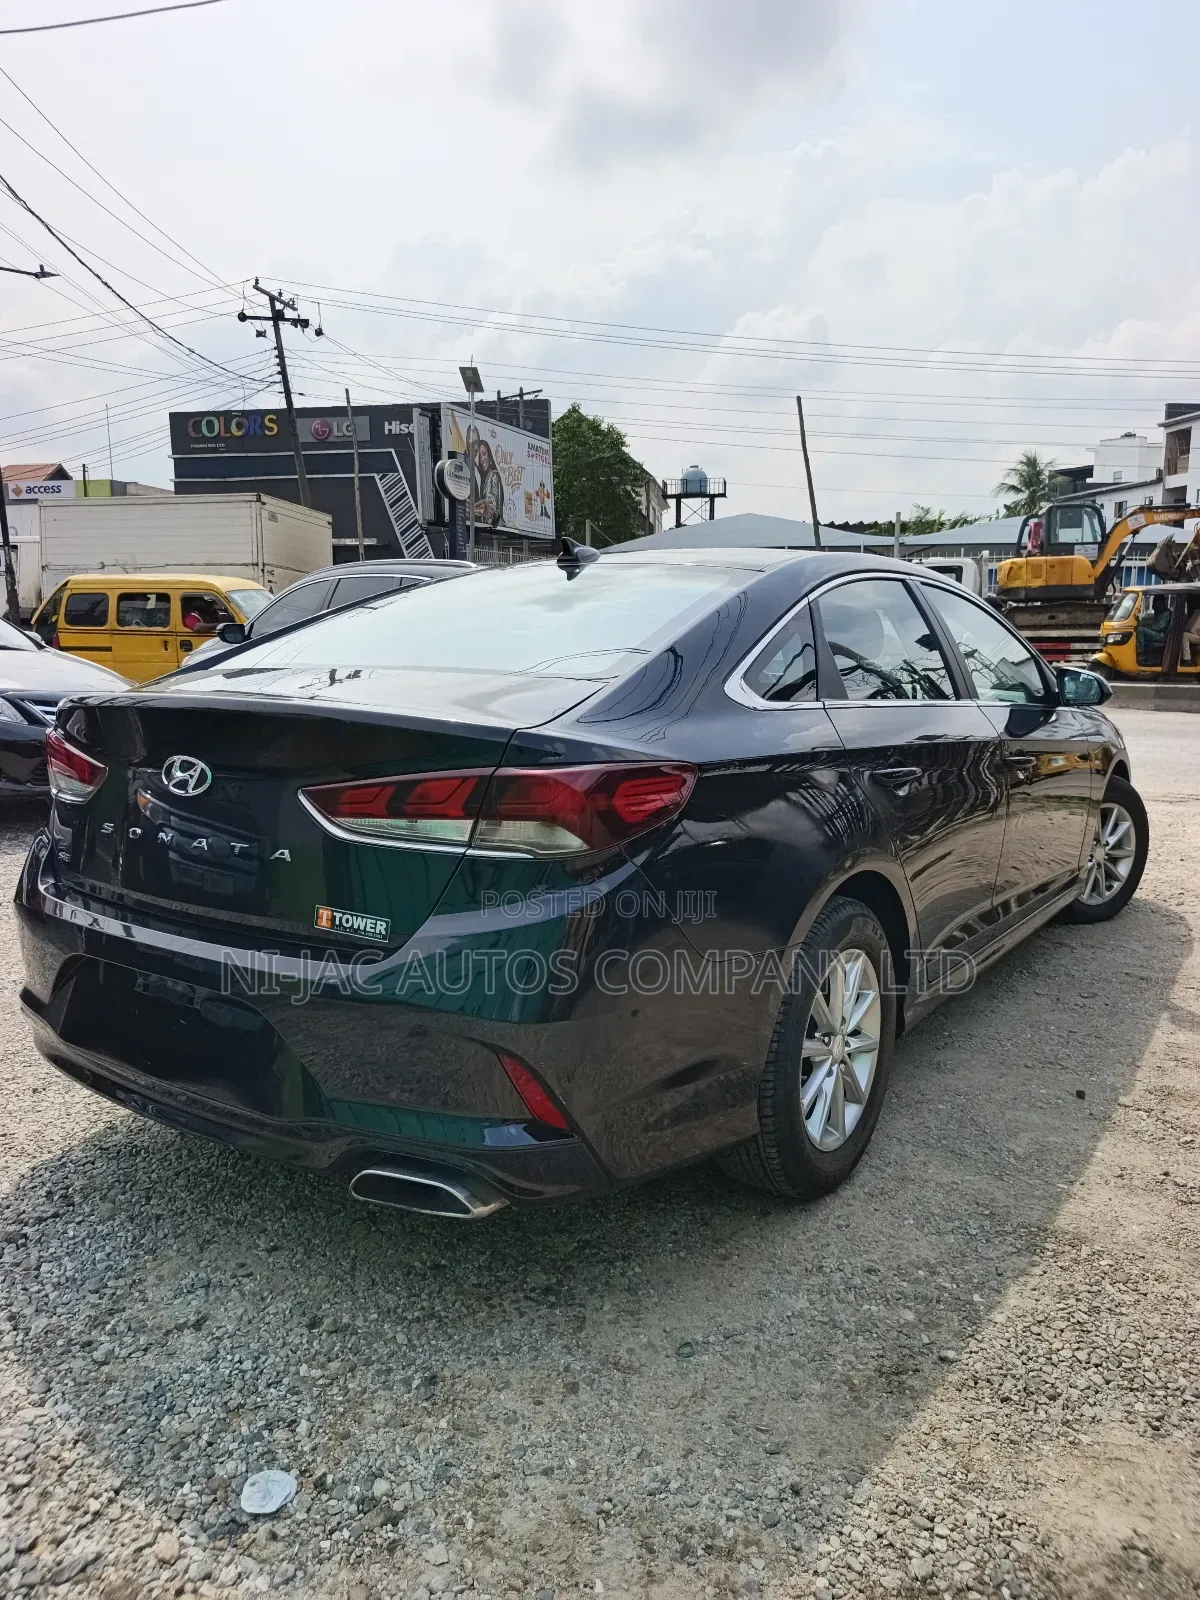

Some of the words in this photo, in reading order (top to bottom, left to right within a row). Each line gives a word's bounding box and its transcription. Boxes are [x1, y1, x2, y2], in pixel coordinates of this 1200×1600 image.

[187, 414, 278, 438] COLORS
[333, 420, 355, 437] LG
[25, 484, 62, 495] access
[100, 822, 292, 862] SONATA
[333, 912, 387, 935] TOWER
